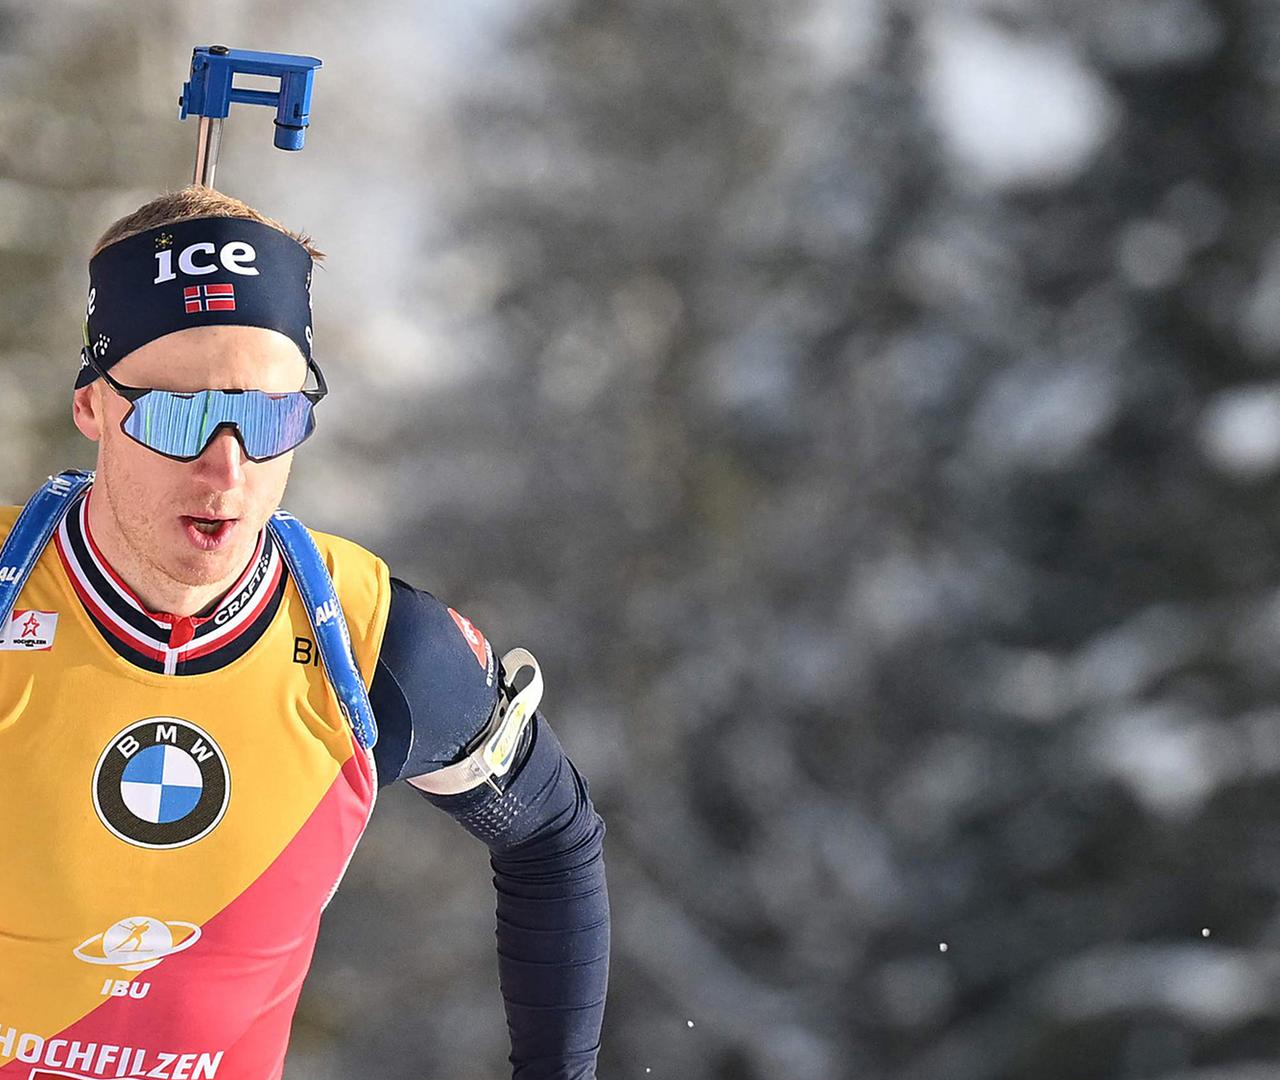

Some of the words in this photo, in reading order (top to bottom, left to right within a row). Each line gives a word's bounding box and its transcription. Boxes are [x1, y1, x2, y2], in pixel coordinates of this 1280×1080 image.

[153, 233, 260, 285] ice
[214, 567, 262, 626] CRAFT
[116, 724, 215, 763] BMW
[100, 978, 151, 999] IBU
